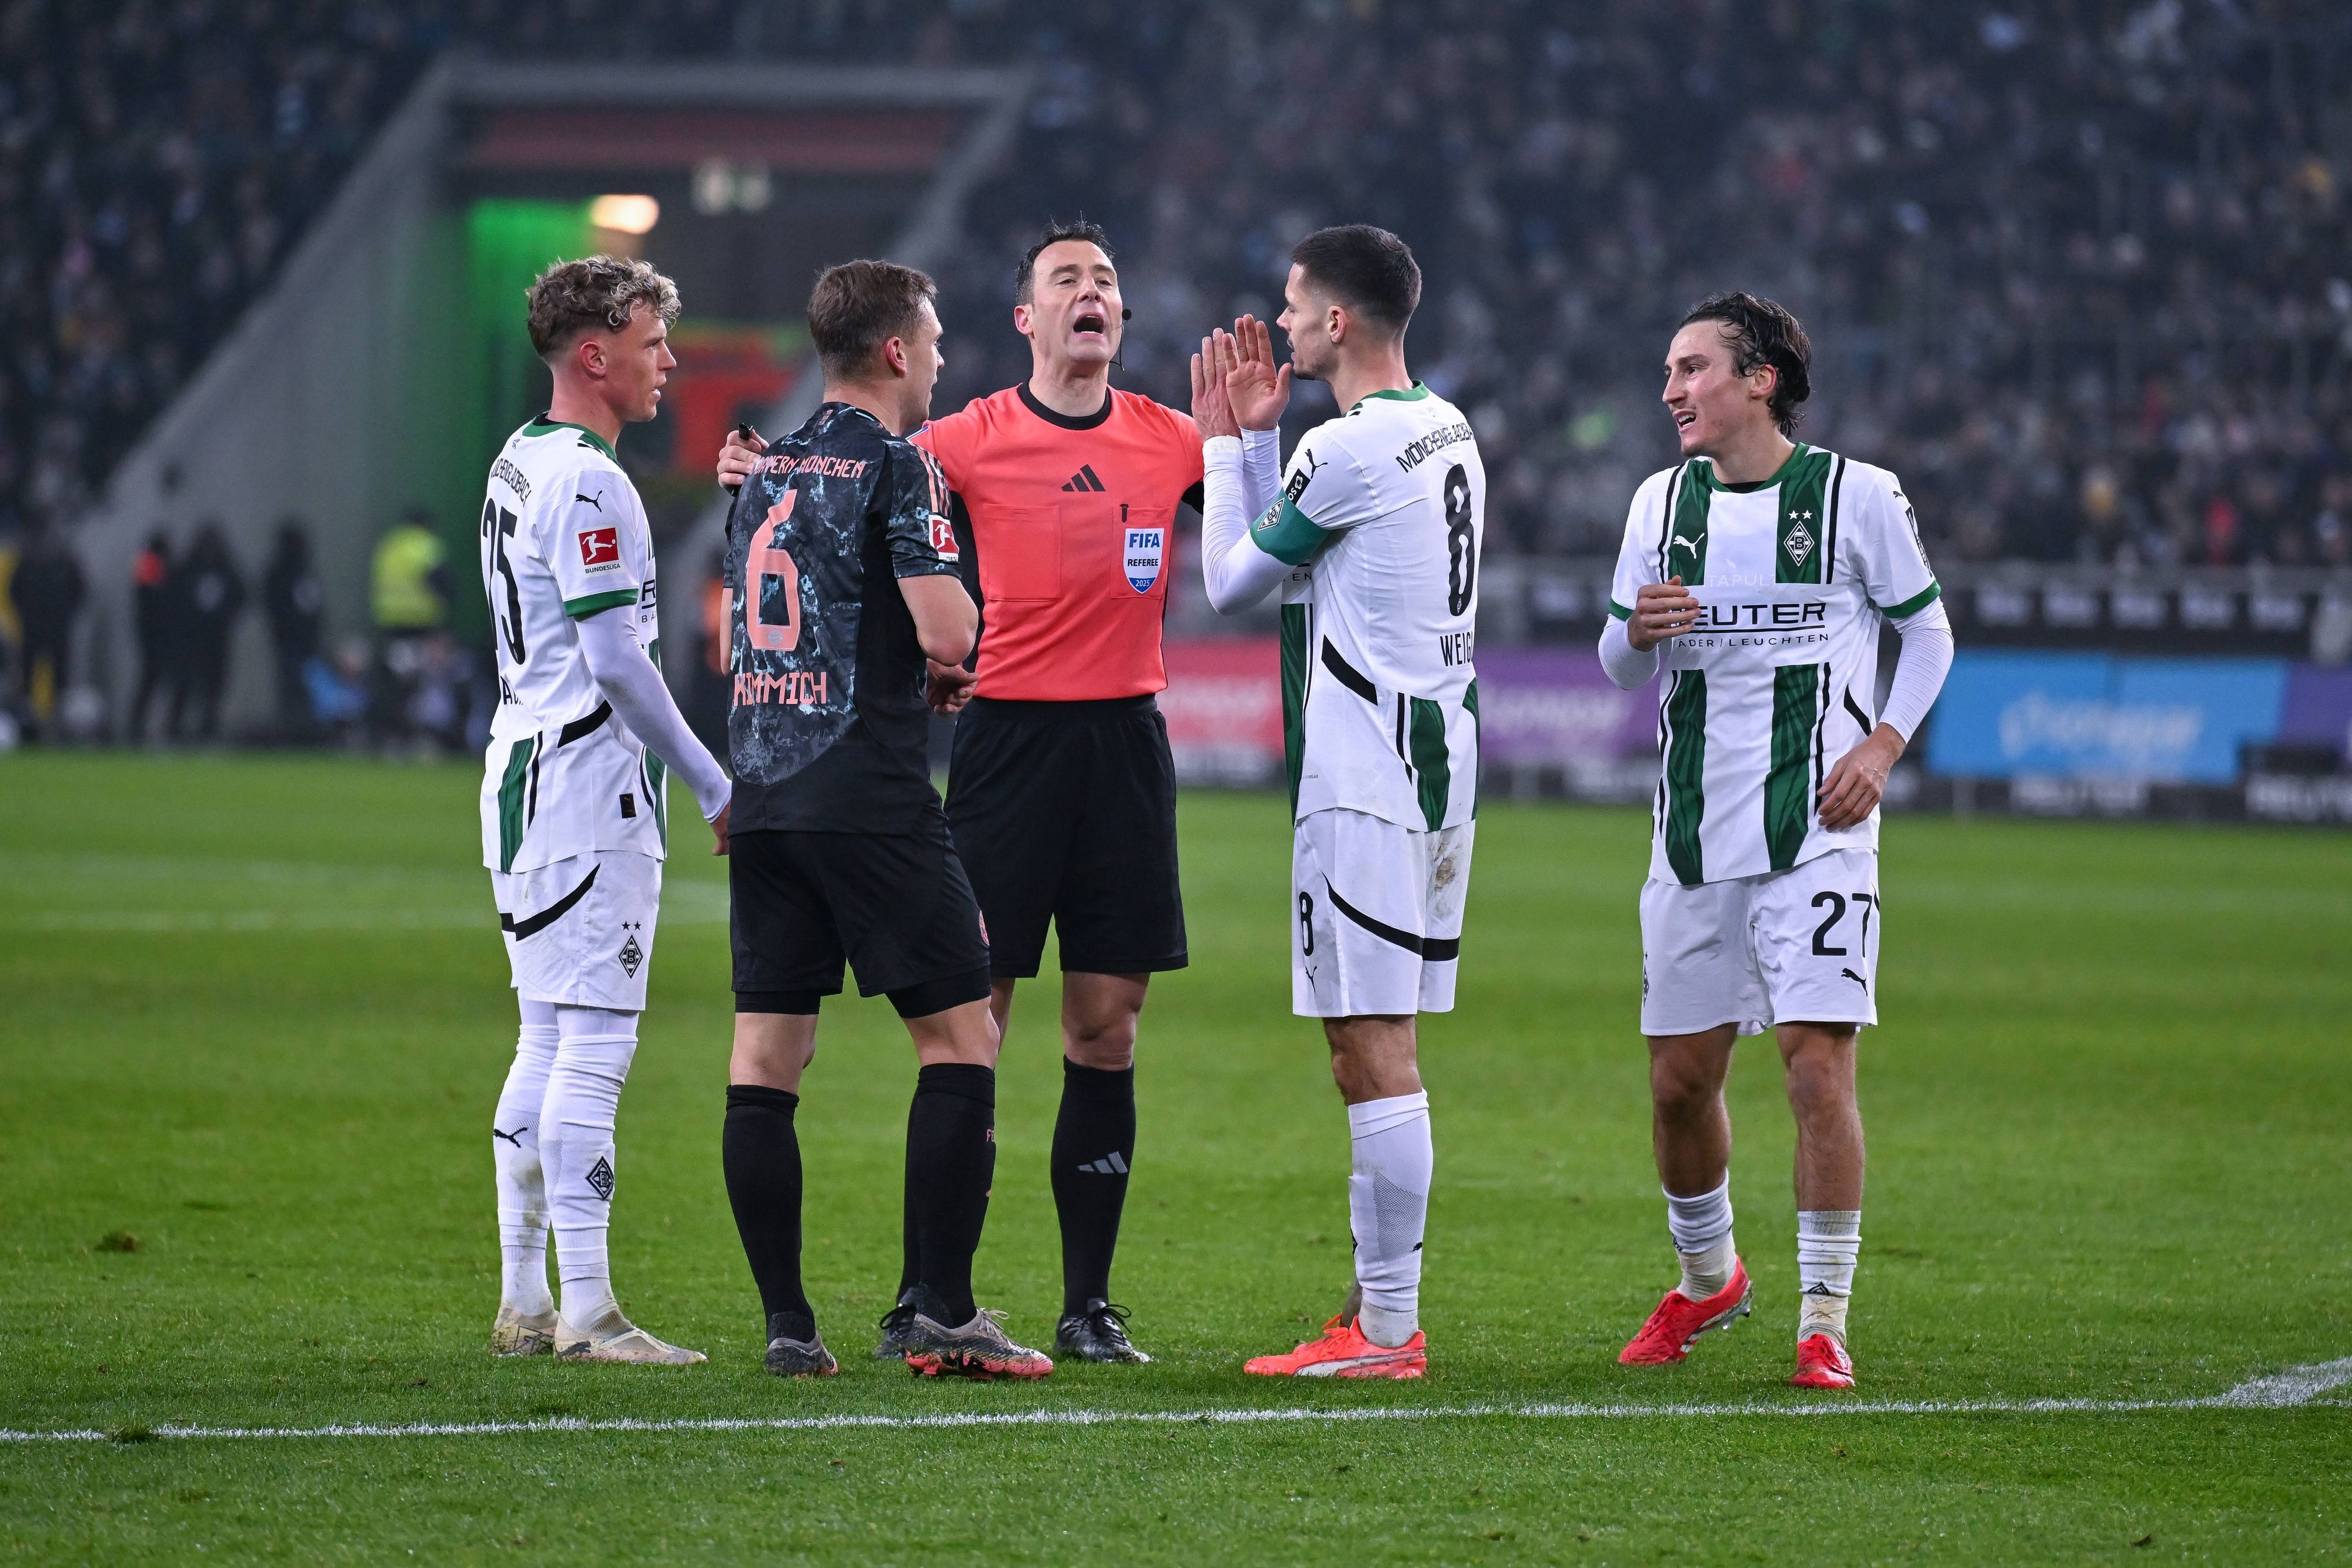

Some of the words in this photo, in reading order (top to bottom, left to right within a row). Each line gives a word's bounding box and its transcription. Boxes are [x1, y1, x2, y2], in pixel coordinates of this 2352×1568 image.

[796, 455, 866, 479] MÜNCHEN
[1129, 533, 1160, 548] FIFA
[1444, 463, 1475, 617] 8
[585, 563, 621, 574] BUNDESLIGA
[746, 489, 801, 651] 6
[1127, 559, 1159, 567] REFEREE
[1669, 603, 1826, 627] EUTER
[1673, 638, 1715, 648] ÄDER
[1729, 633, 1829, 646] LEUCHTEN
[734, 671, 826, 706] KIMMICH
[1299, 891, 1314, 957] 8
[1811, 891, 1872, 958] 27
